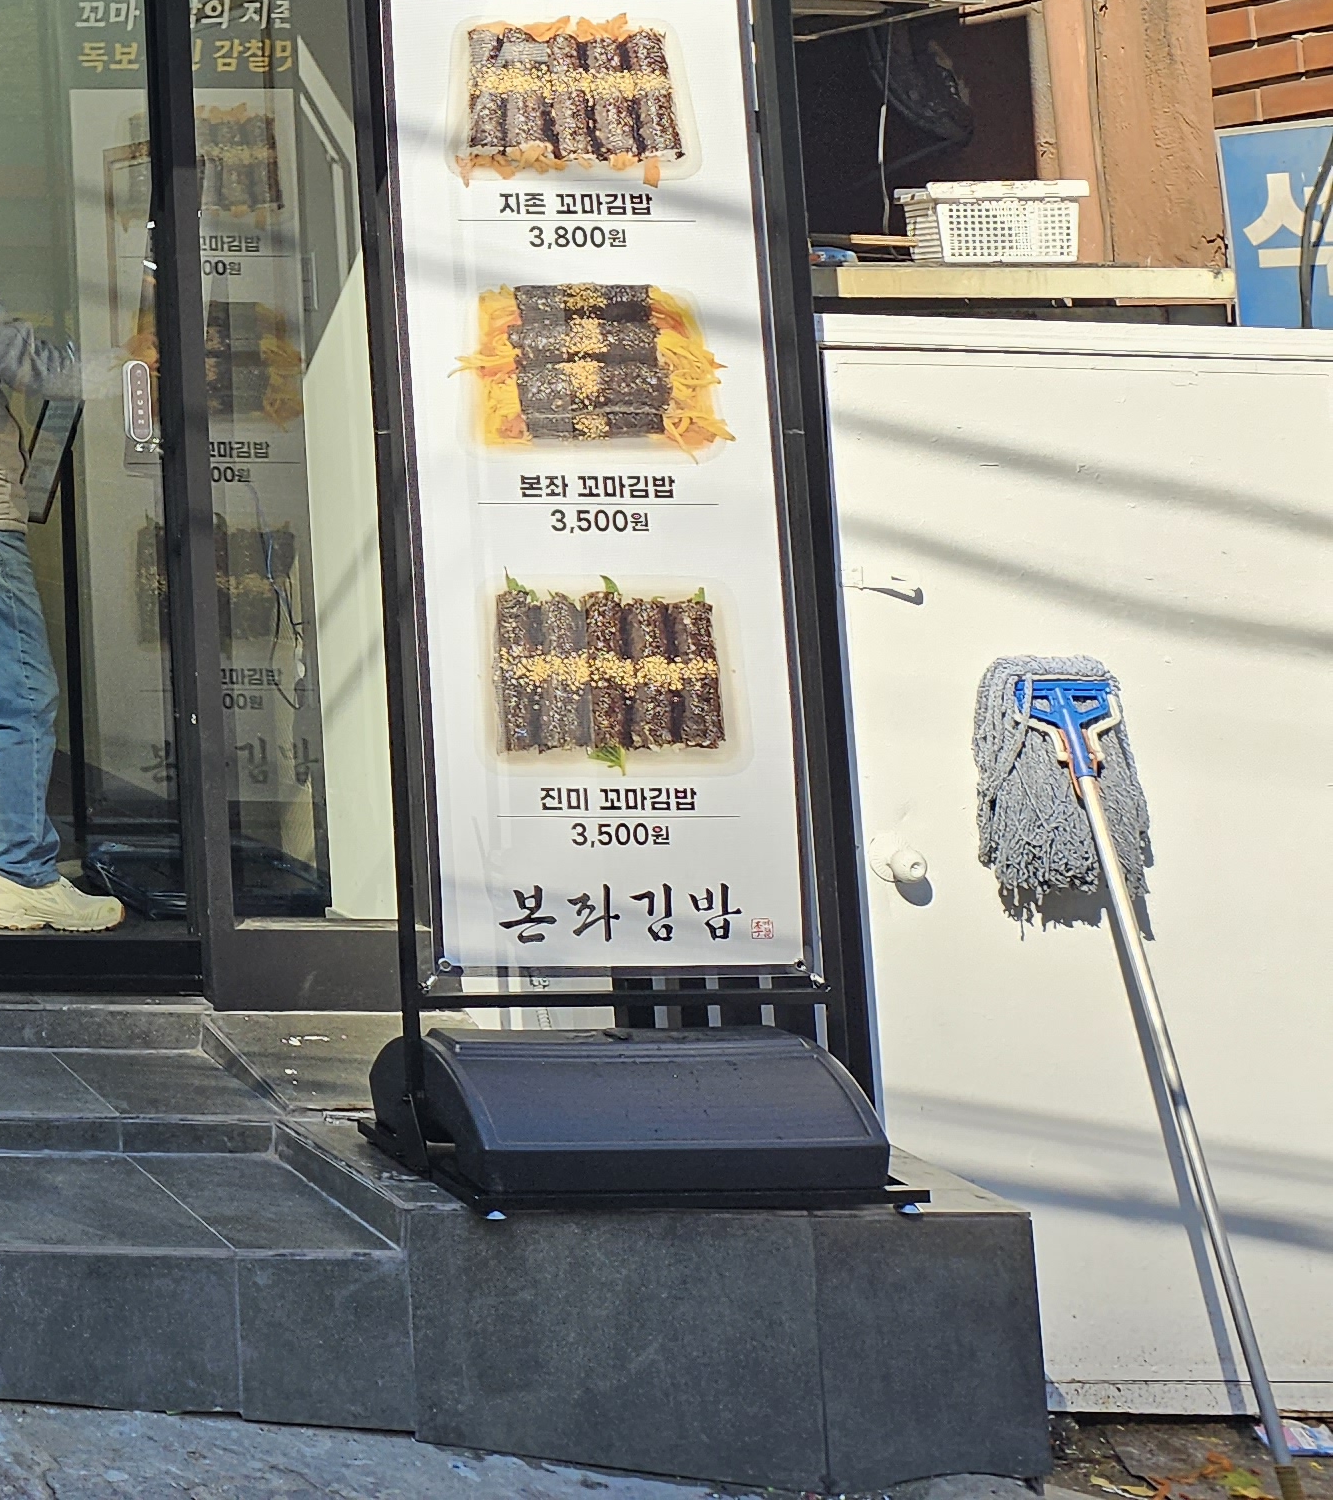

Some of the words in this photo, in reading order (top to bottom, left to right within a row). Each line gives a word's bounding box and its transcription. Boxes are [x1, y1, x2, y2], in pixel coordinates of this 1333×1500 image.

[499, 192, 548, 216] 지존
[555, 192, 654, 217] 꼬마김밥
[528, 225, 628, 250] 3,800원
[519, 474, 569, 500] 본좌
[577, 474, 676, 500] 꼬마김밥
[550, 509, 650, 535] 3,500원
[539, 786, 590, 812] 진미
[599, 786, 698, 813] 꼬마김밥
[570, 822, 671, 849] 3,500원
[499, 882, 743, 945] 본좌김밥
